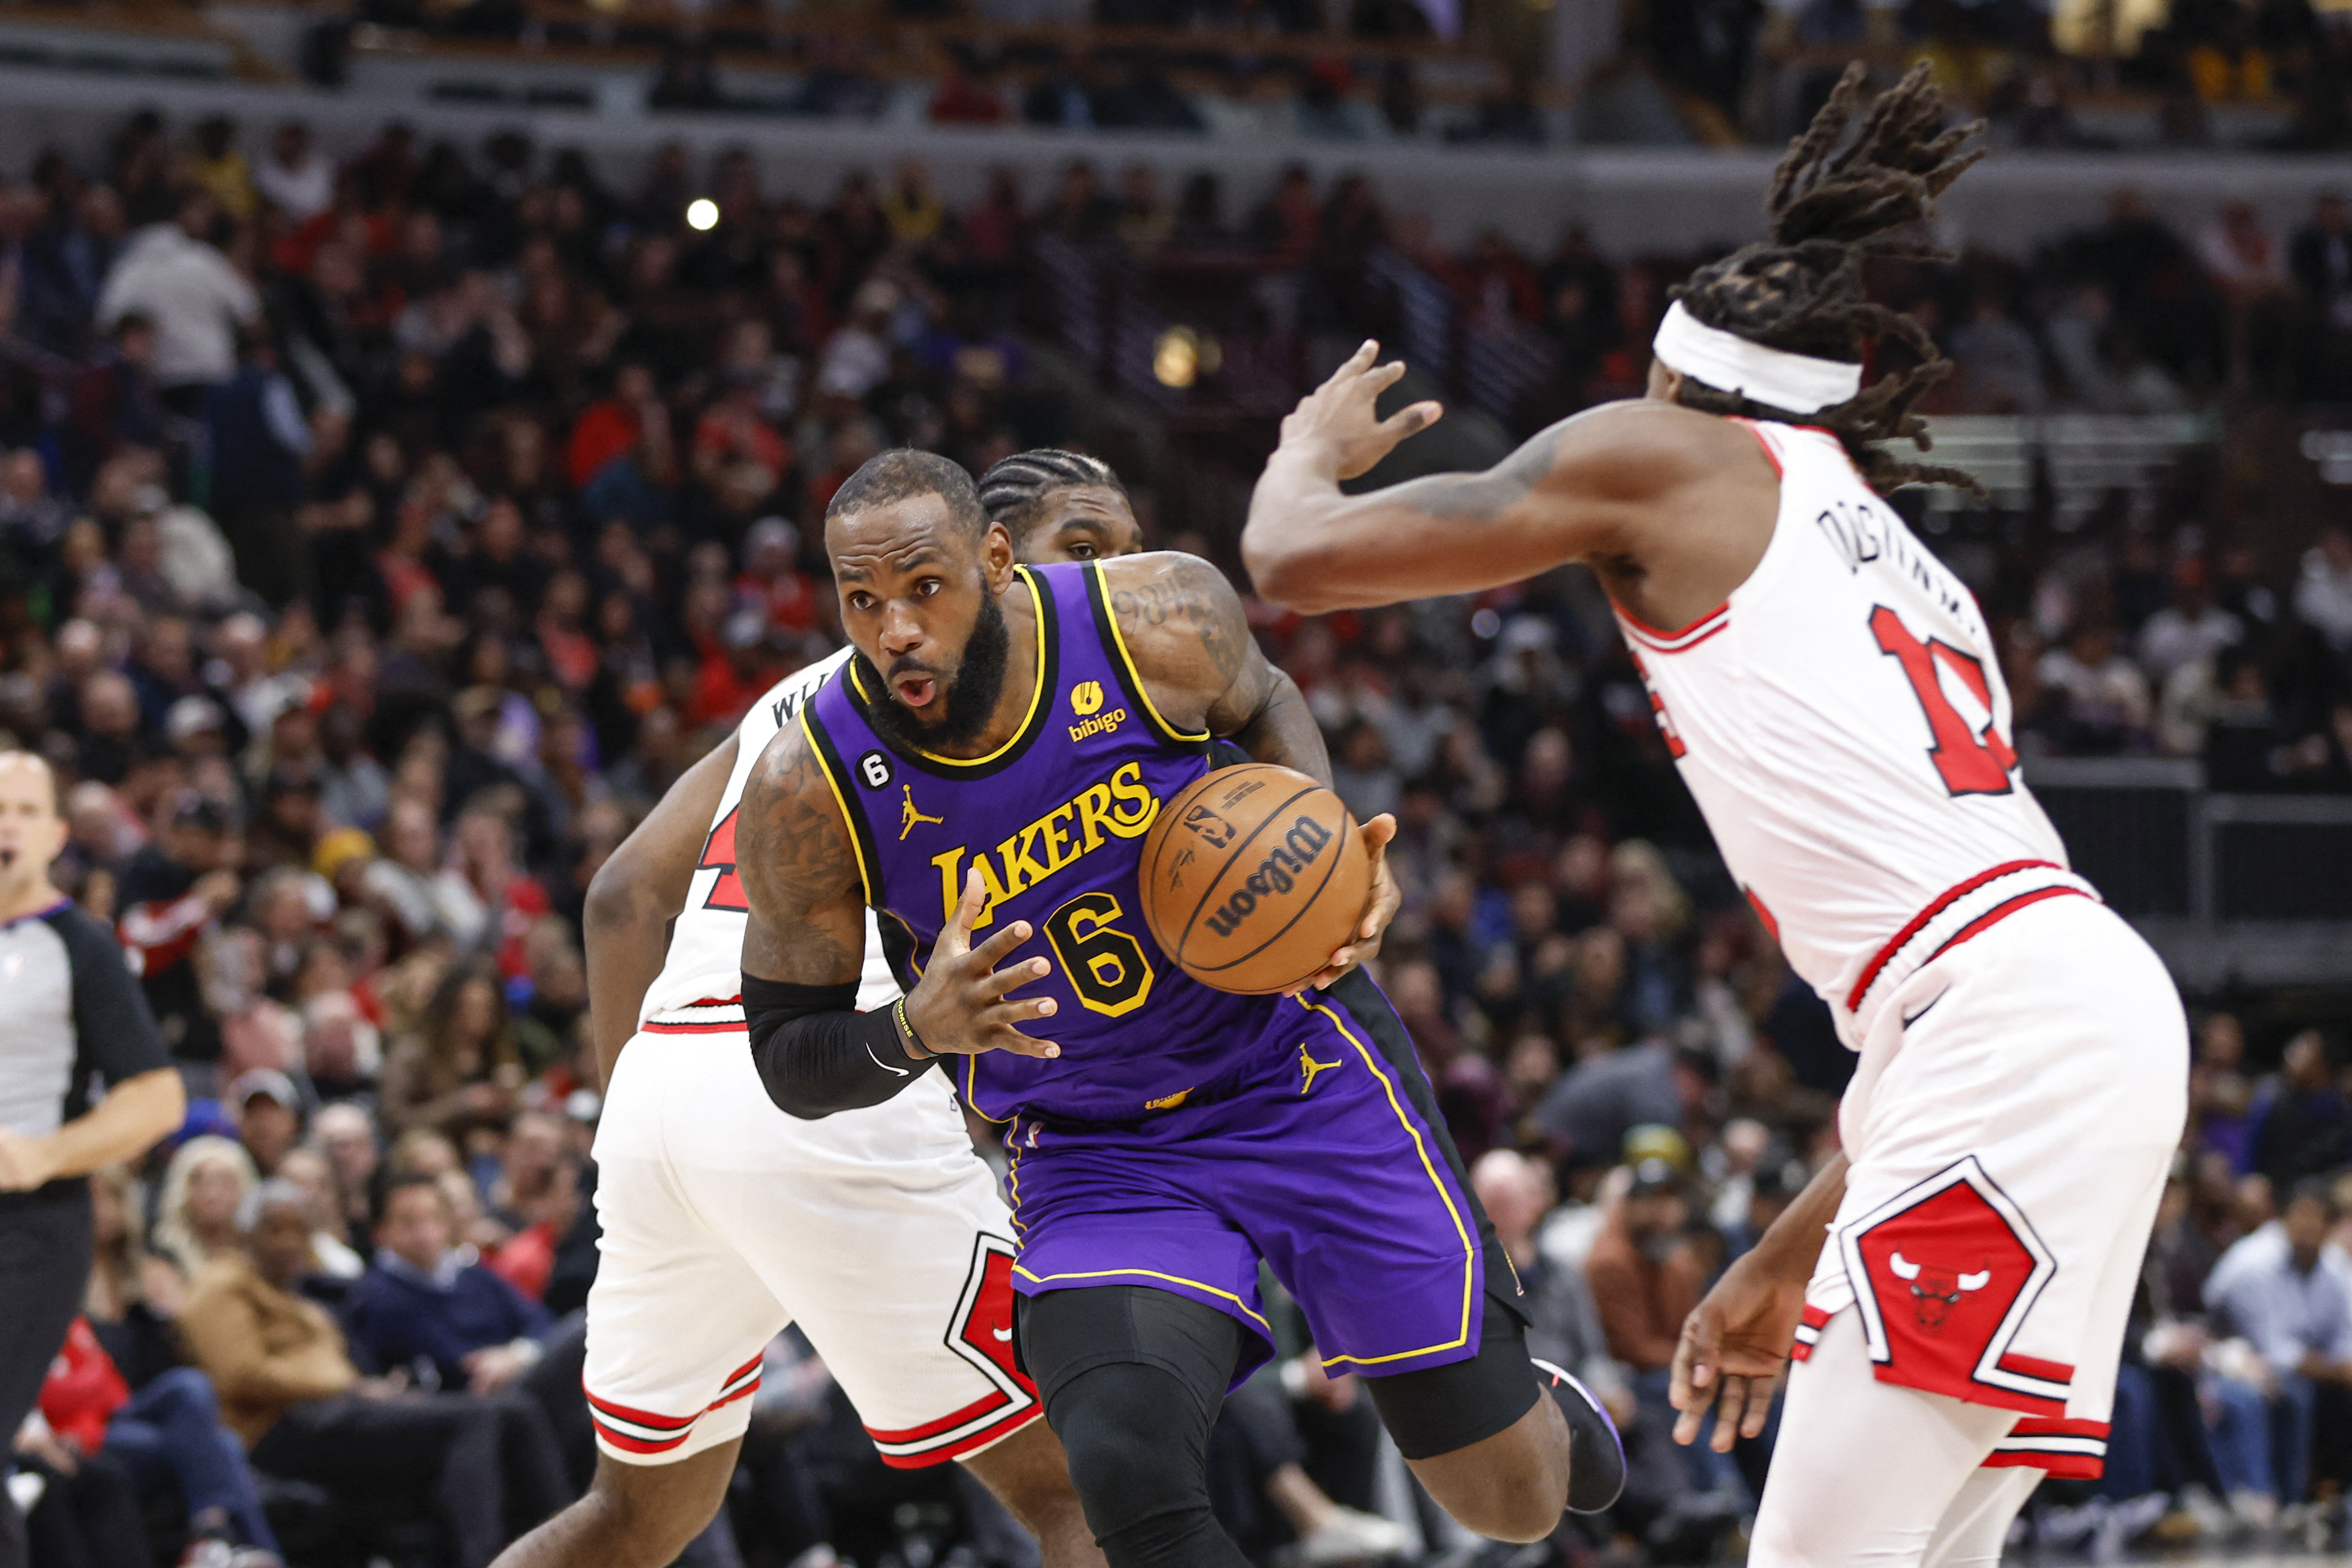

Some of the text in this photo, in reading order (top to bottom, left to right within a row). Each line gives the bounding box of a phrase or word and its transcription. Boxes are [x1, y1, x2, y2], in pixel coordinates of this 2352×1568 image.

[862, 753, 890, 787] 6
[1067, 708, 1127, 743] bibigo
[931, 761, 1161, 932] LAKERS
[1204, 815, 1333, 938] Wilson
[1042, 891, 1155, 1018] 6
